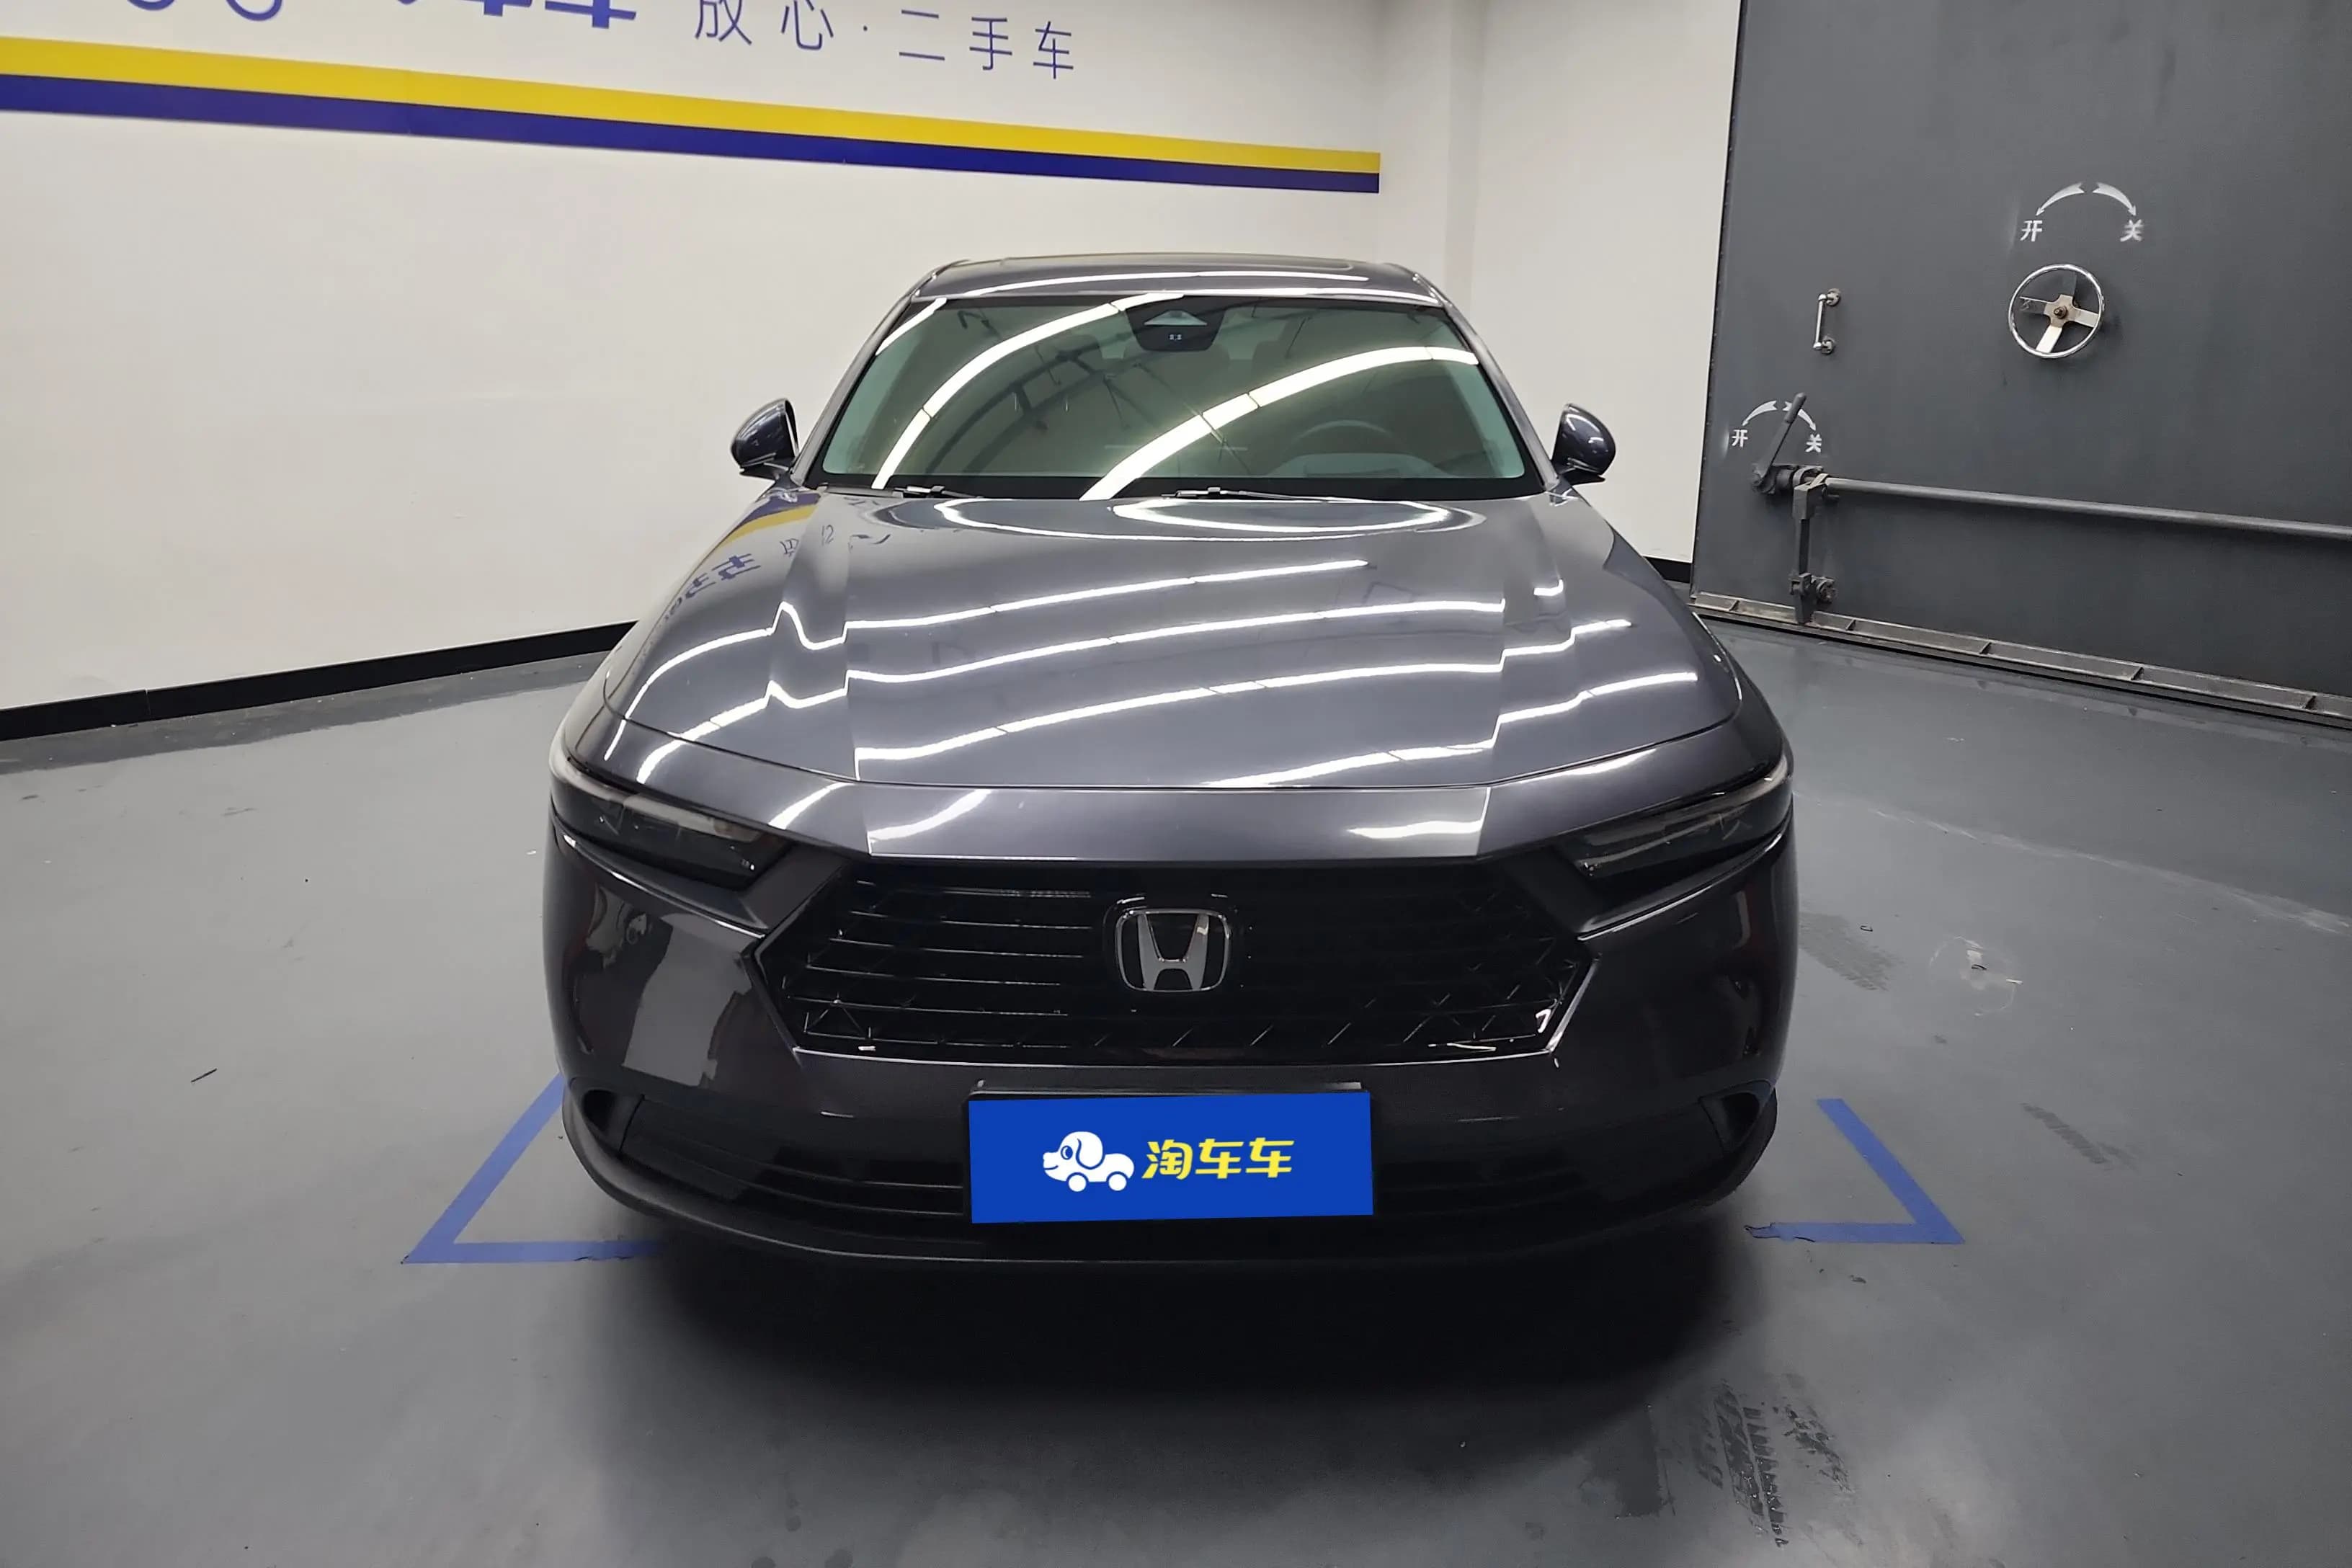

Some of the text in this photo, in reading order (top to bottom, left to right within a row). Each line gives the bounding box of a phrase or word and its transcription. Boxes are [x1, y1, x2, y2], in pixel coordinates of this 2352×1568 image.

[2020, 219, 2044, 242] 开
[2119, 219, 2144, 242] 关
[1731, 429, 1749, 448] 开
[1804, 434, 1823, 454] 关
